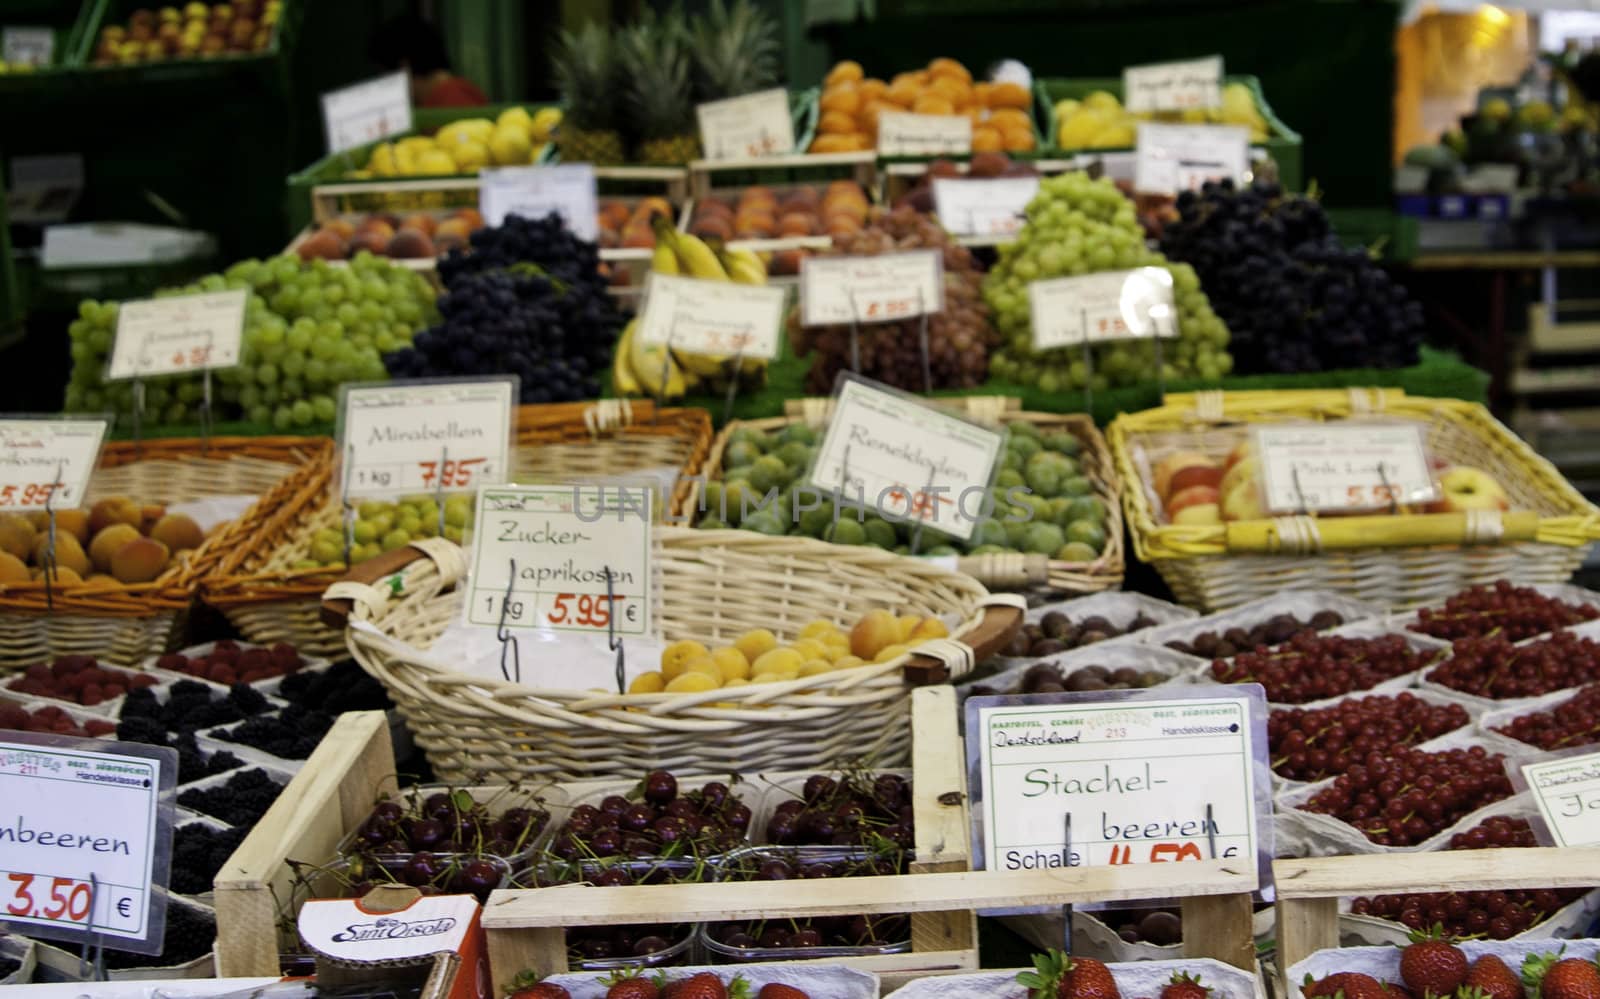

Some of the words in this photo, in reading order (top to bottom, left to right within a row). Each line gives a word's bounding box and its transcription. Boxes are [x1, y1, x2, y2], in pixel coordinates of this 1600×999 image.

[368, 421, 483, 446] Mirabellen
[358, 471, 365, 483] 1
[371, 470, 391, 486] kg
[497, 519, 592, 545] Zucker-
[520, 558, 634, 588] aprikosen
[485, 596, 493, 614] 1
[503, 596, 524, 620] kg
[547, 592, 627, 628] 5.95
[626, 604, 638, 622] €
[1105, 726, 1128, 740] 213
[1021, 761, 1168, 798] Stachel-
[1102, 811, 1220, 841] beeren
[7, 872, 94, 922] 3.50
[116, 896, 133, 918] €
